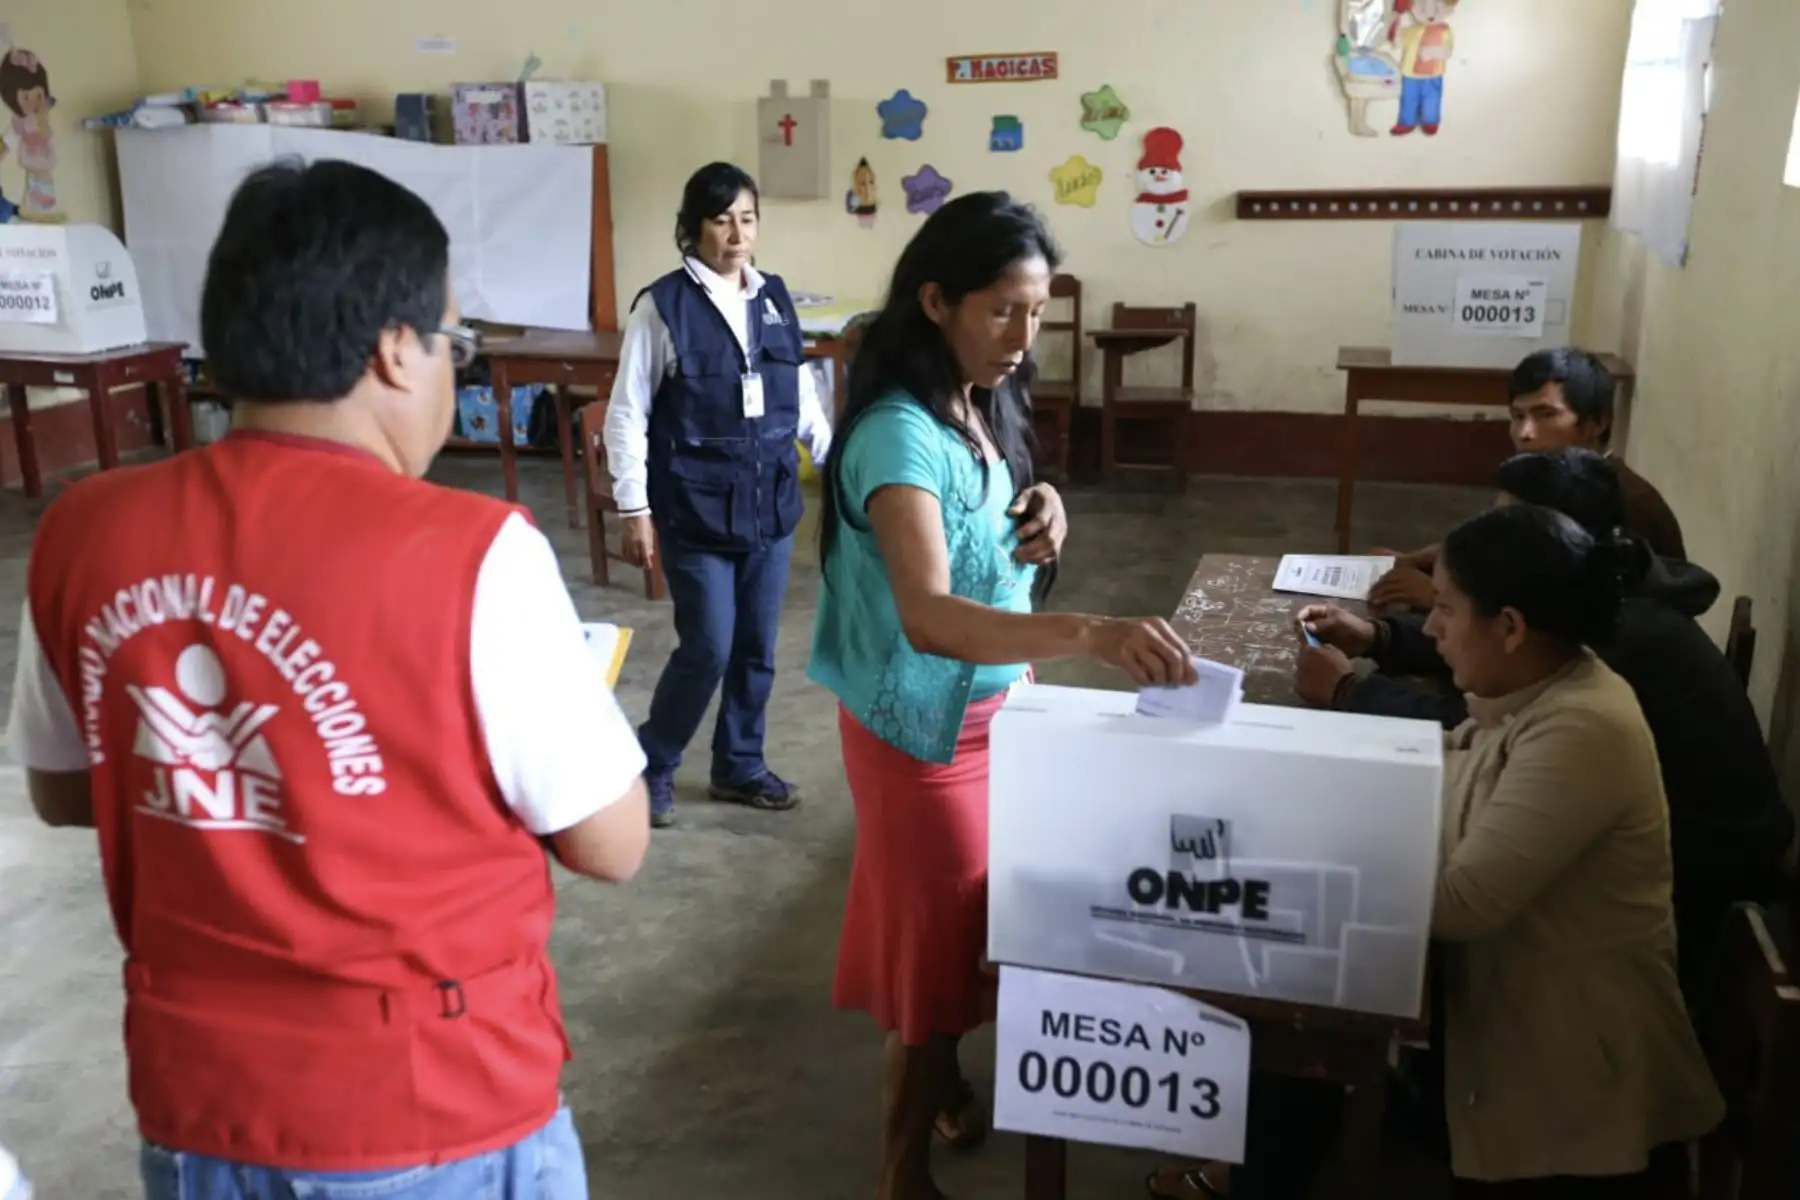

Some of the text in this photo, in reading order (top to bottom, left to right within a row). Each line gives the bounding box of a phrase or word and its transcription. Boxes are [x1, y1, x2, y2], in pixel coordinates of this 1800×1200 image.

[1415, 246, 1561, 262] CABINA DE VOTACIÓN
[90, 281, 125, 301] ONPE
[1470, 288, 1511, 300] MESA
[1461, 304, 1536, 324] 000013
[218, 583, 268, 641] DE
[255, 608, 388, 797] ELECCIONES
[143, 766, 287, 827] JNE
[1126, 866, 1271, 922] ONPE
[1040, 1009, 1152, 1052] MESA
[1017, 1049, 1222, 1121] 000013
